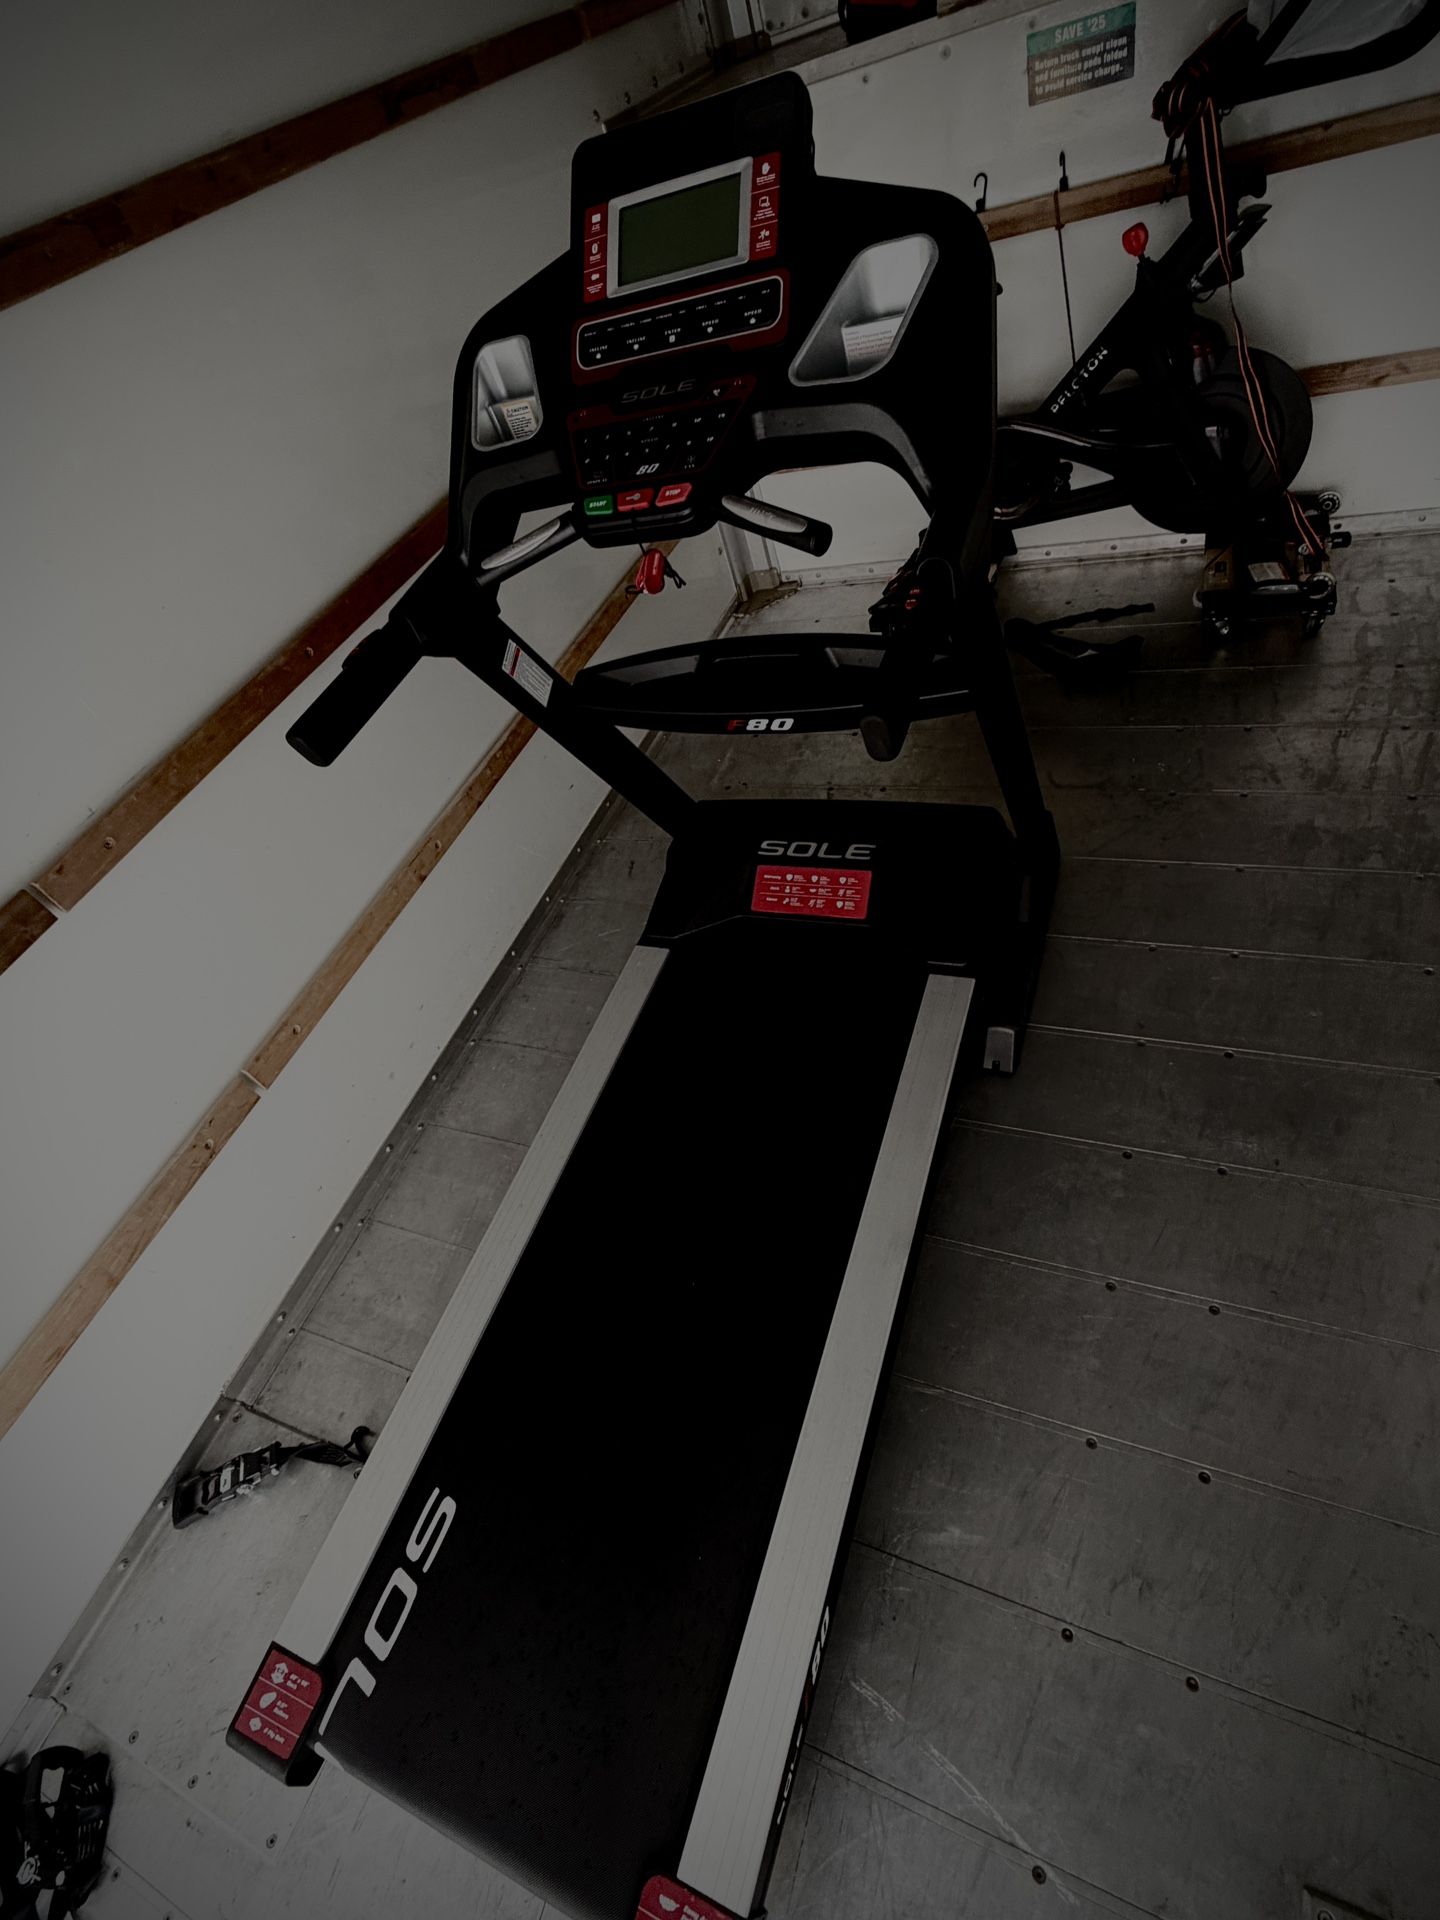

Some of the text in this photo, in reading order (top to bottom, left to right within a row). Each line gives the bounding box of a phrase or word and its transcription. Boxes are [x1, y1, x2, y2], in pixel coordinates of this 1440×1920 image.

[1054, 22, 1084, 43] SAVE
[1103, 47, 1128, 63] folded
[620, 378, 697, 404] SOLE
[635, 463, 661, 476] 80
[725, 717, 795, 734] F80
[757, 840, 877, 861] SOLE
[314, 1486, 457, 1770] SOL
